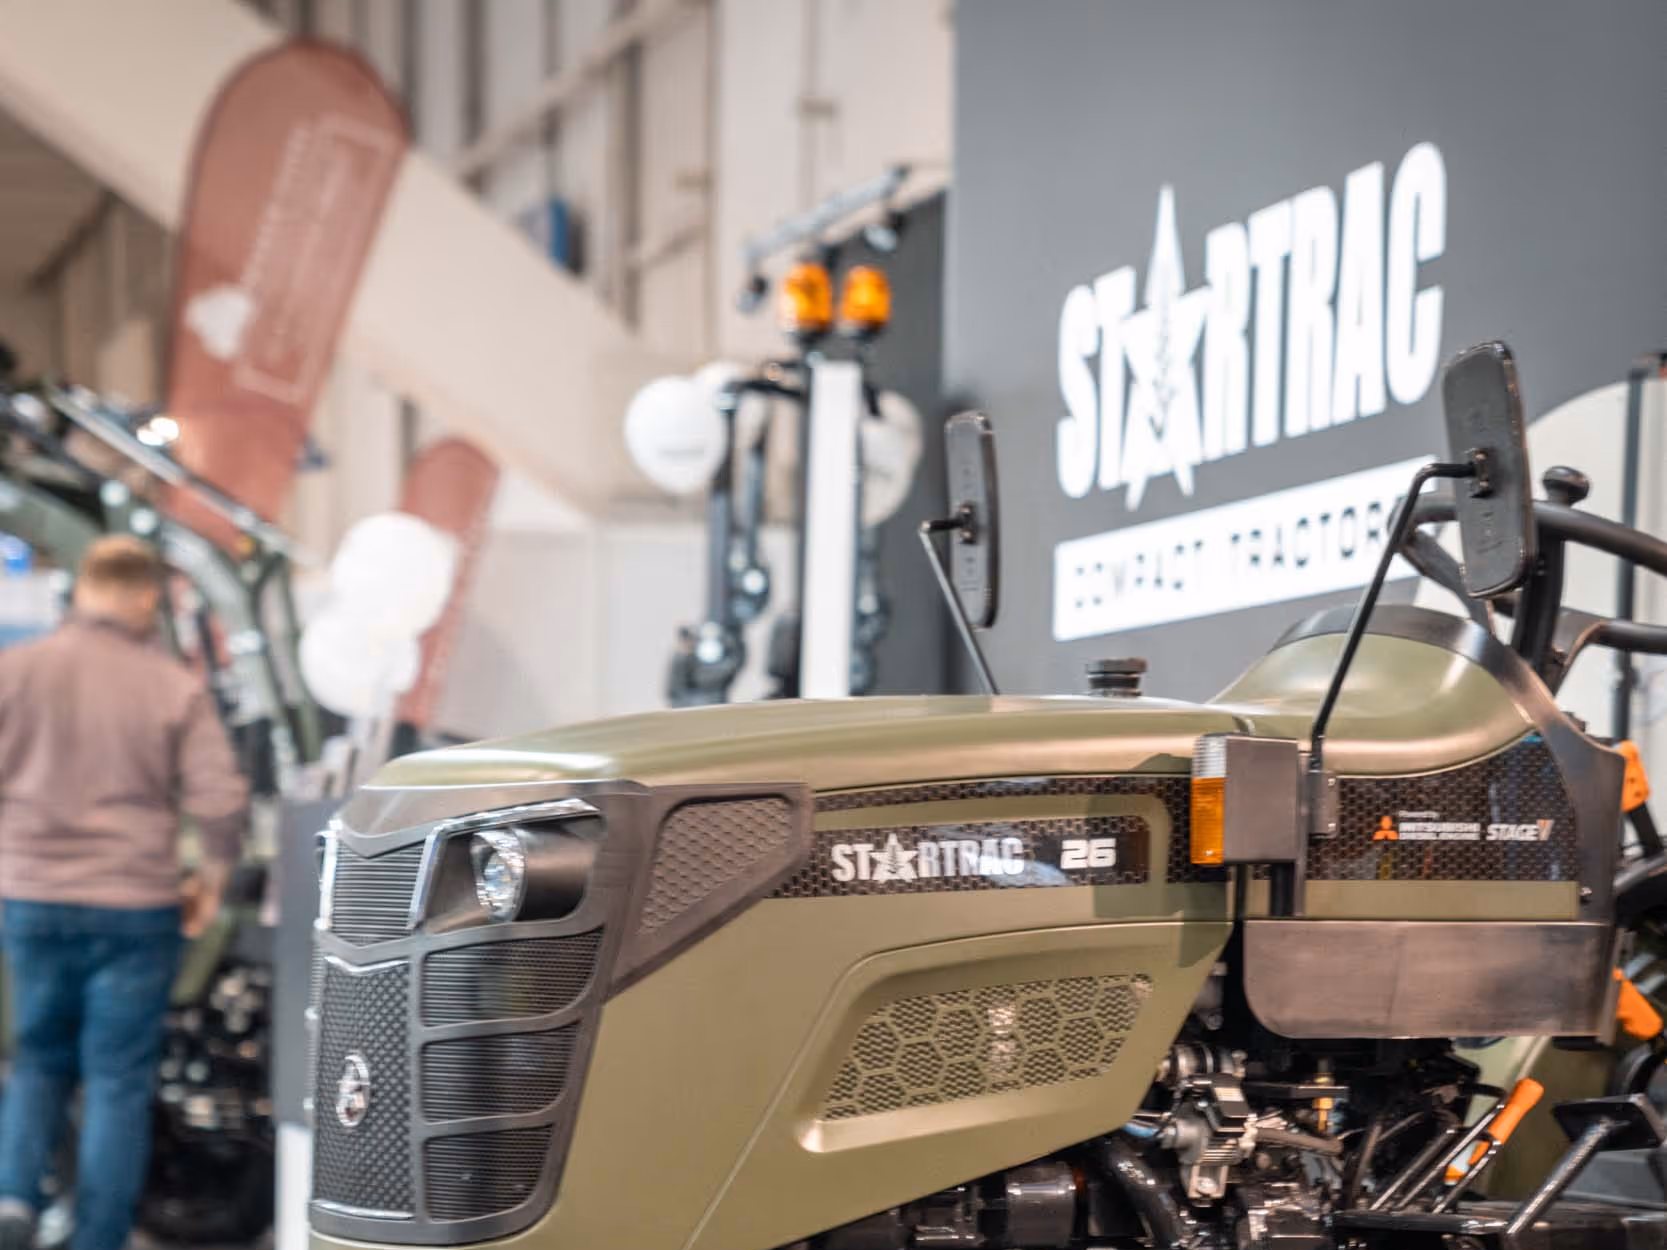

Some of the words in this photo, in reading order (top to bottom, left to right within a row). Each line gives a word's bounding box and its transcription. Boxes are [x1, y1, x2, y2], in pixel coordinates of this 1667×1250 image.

[1057, 141, 1446, 511] STARTRAC
[1229, 495, 1407, 581] TRACTOR
[831, 833, 1025, 884] STARTRAC
[1059, 837, 1117, 870] 26
